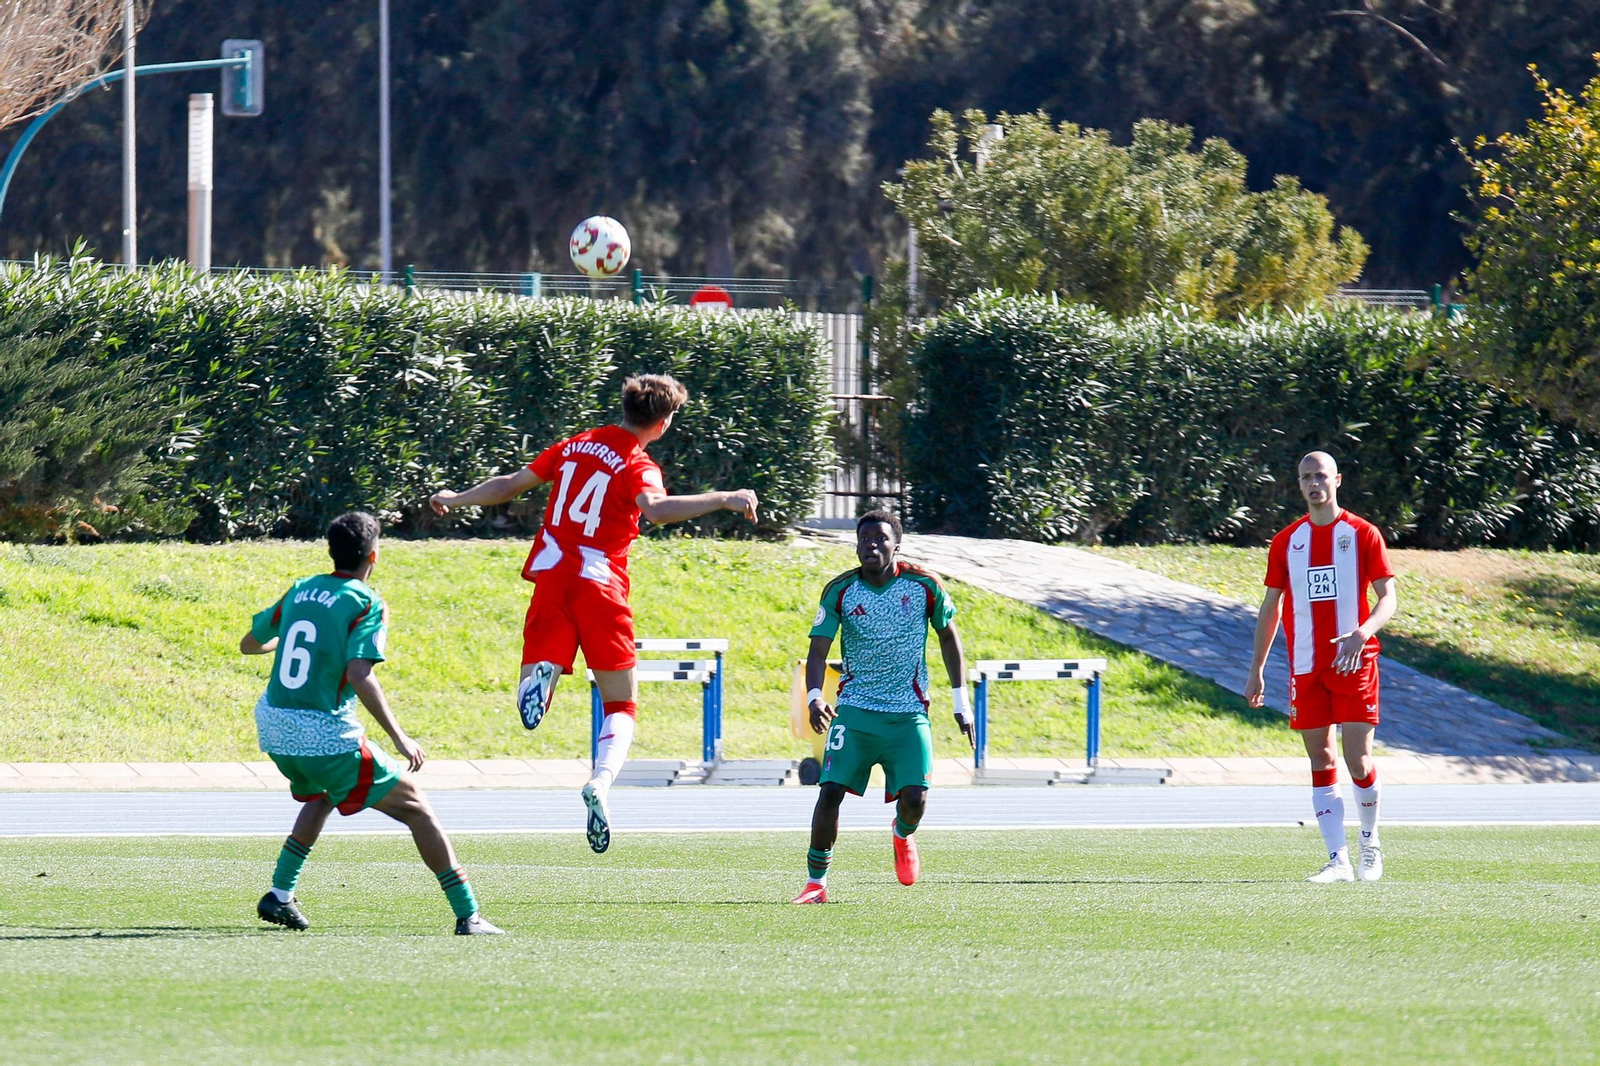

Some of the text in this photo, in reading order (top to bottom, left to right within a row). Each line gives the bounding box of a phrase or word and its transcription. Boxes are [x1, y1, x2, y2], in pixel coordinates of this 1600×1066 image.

[551, 461, 612, 538] 14
[1313, 573, 1330, 583] DA
[294, 588, 338, 609] ULLOA
[1314, 584, 1330, 594] ZN
[279, 620, 317, 690] 6
